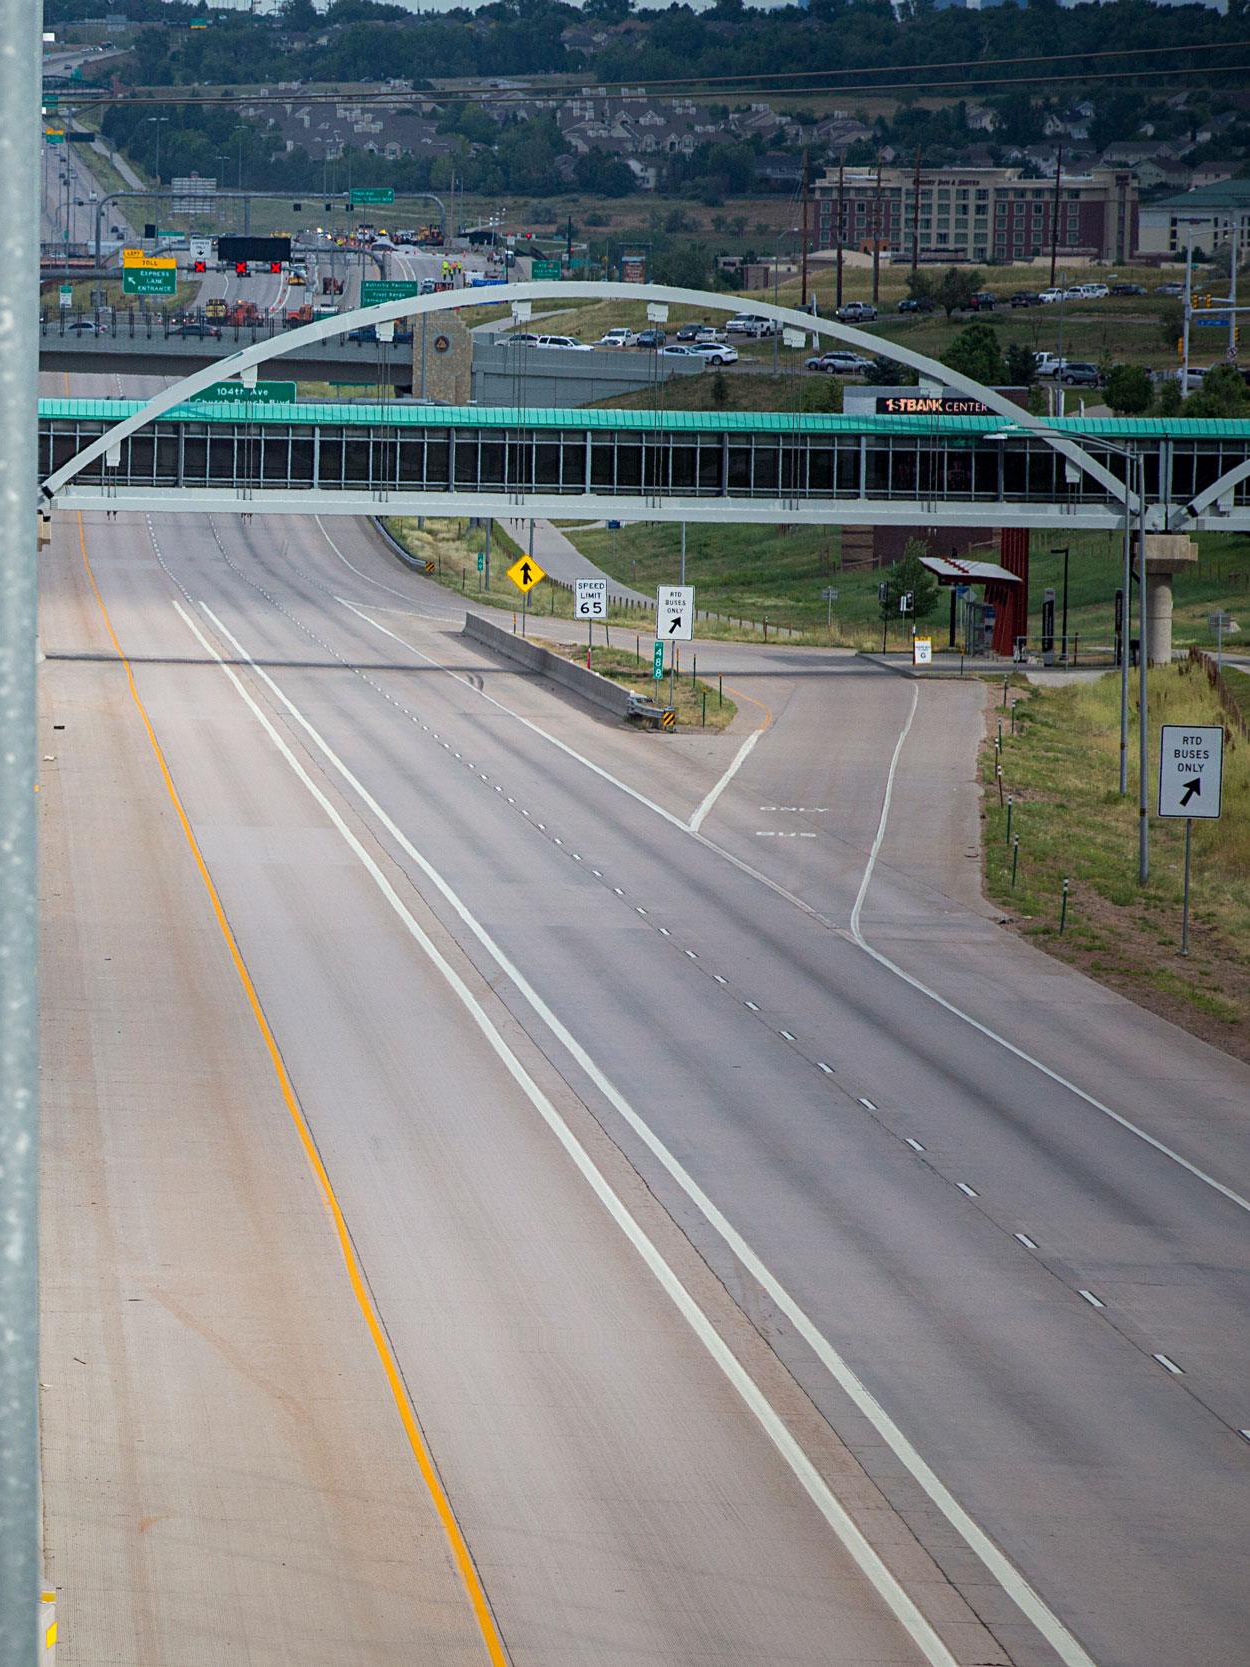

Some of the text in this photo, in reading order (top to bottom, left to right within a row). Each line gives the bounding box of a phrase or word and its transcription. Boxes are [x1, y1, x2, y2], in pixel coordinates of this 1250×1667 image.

[217, 388, 268, 396] 104th Ave
[945, 402, 988, 412] CENTER
[580, 602, 602, 614] 65
[1182, 736, 1202, 745] RTD
[1174, 749, 1210, 759] BUSES
[1177, 763, 1205, 772] ONLY
